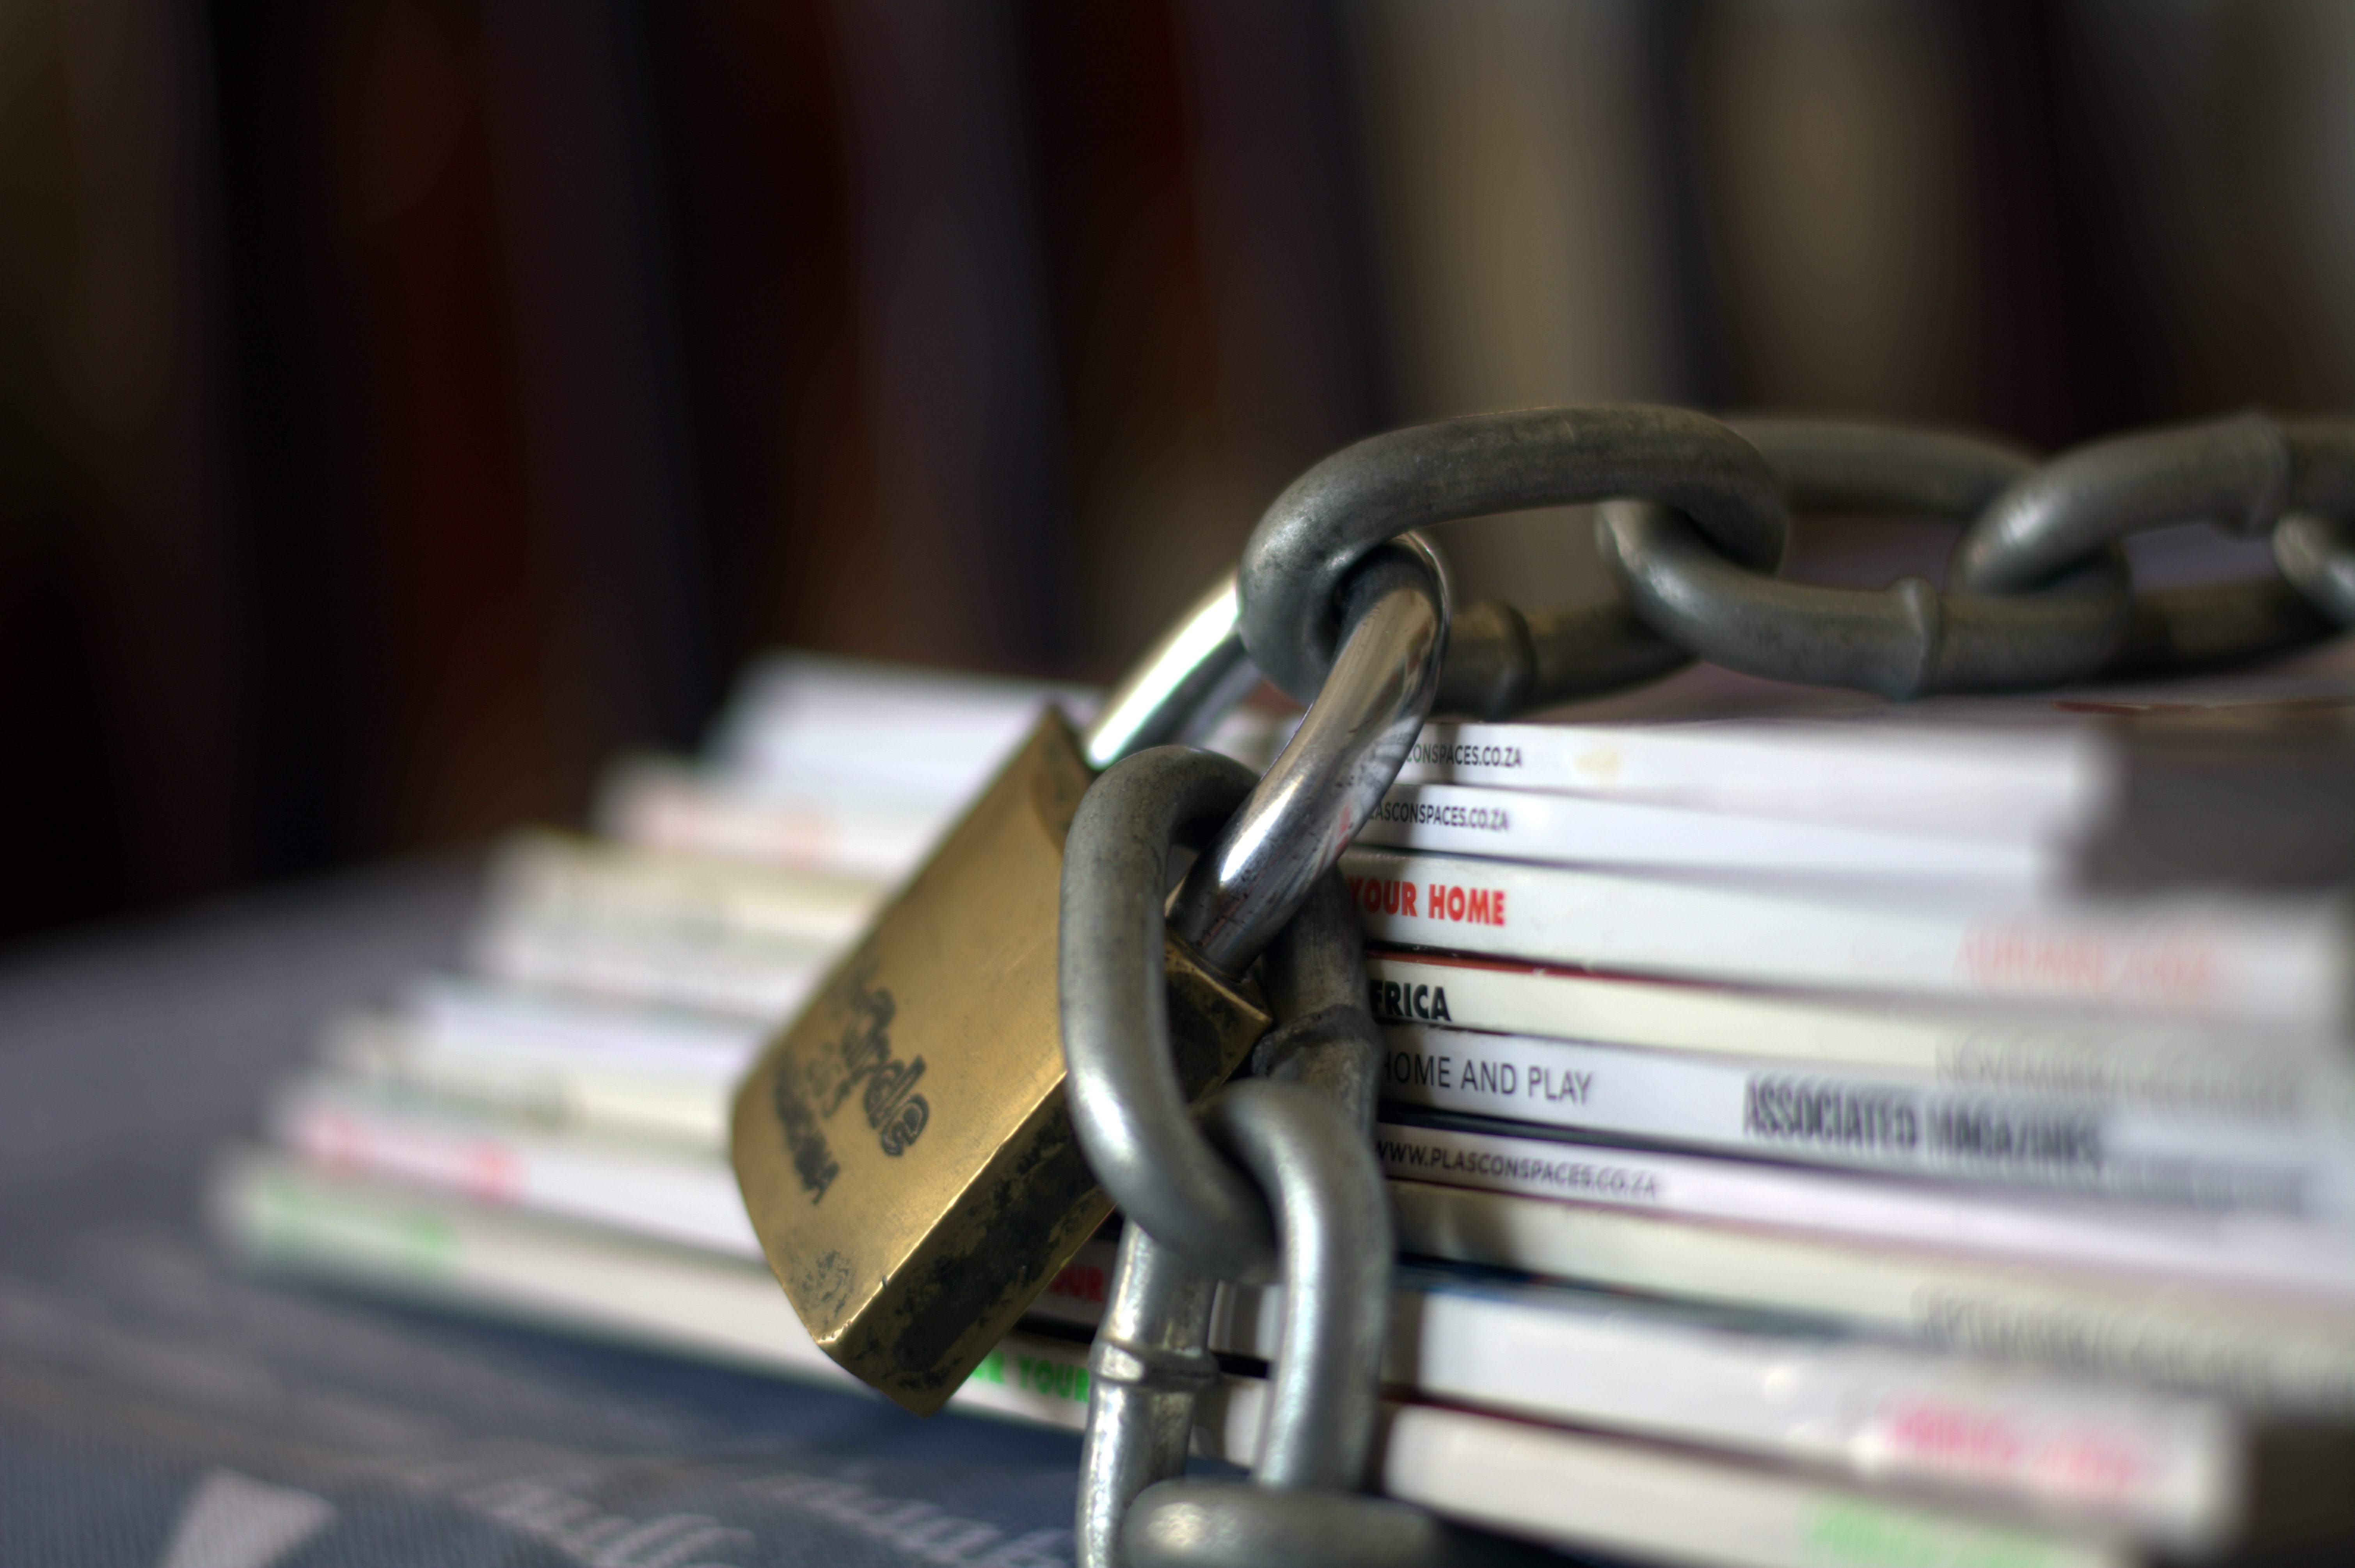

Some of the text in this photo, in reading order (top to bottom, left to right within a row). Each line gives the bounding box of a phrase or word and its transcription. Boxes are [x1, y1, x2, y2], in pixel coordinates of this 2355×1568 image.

[1347, 876, 1506, 927] YOUR HOME
[1460, 1059, 1517, 1095] AND
[1527, 1066, 1593, 1105] PLAY
[1743, 1073, 1918, 1150] ASSOCIATED
[1017, 1352, 1089, 1403] YOUR
